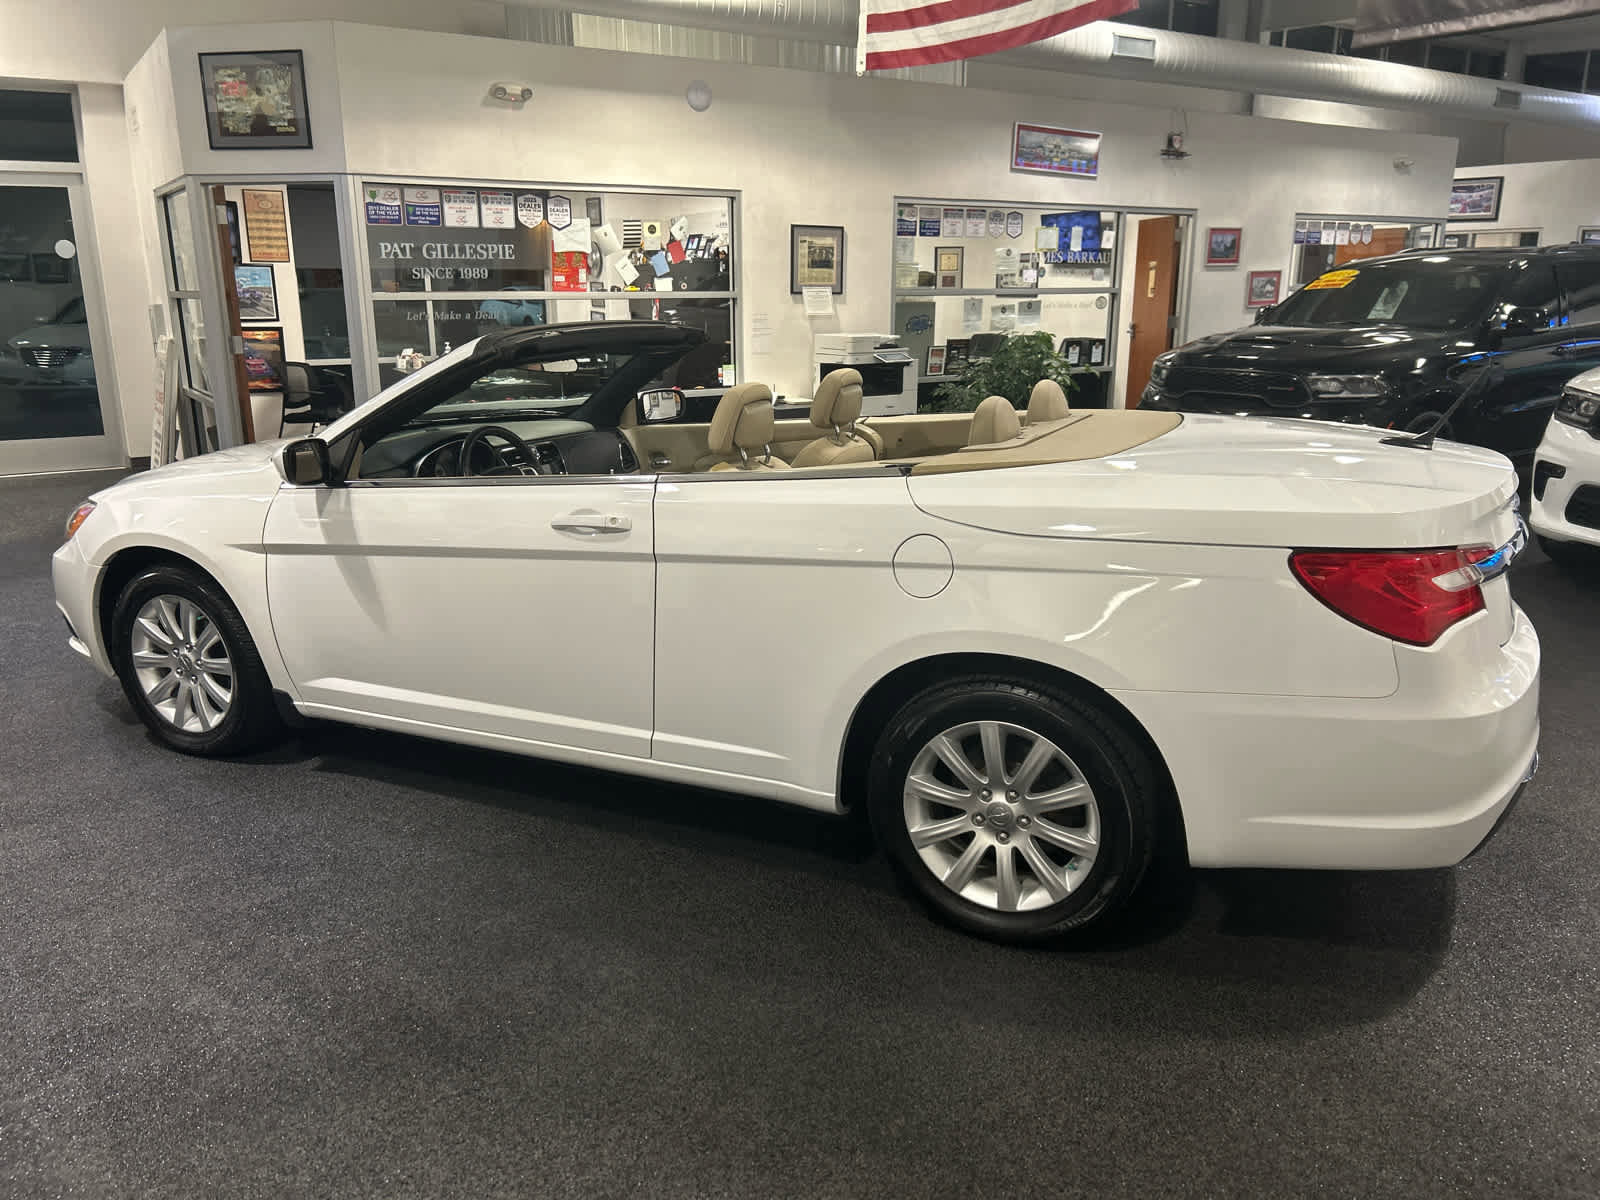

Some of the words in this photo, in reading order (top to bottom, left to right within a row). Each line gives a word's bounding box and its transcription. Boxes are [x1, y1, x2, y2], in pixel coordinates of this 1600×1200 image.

[379, 242, 415, 260] PAT
[422, 242, 516, 260] GILLESPIE
[412, 267, 453, 280] SINCE
[459, 267, 489, 280] 1989
[434, 311, 462, 321] Make
[474, 311, 498, 321] Deal
